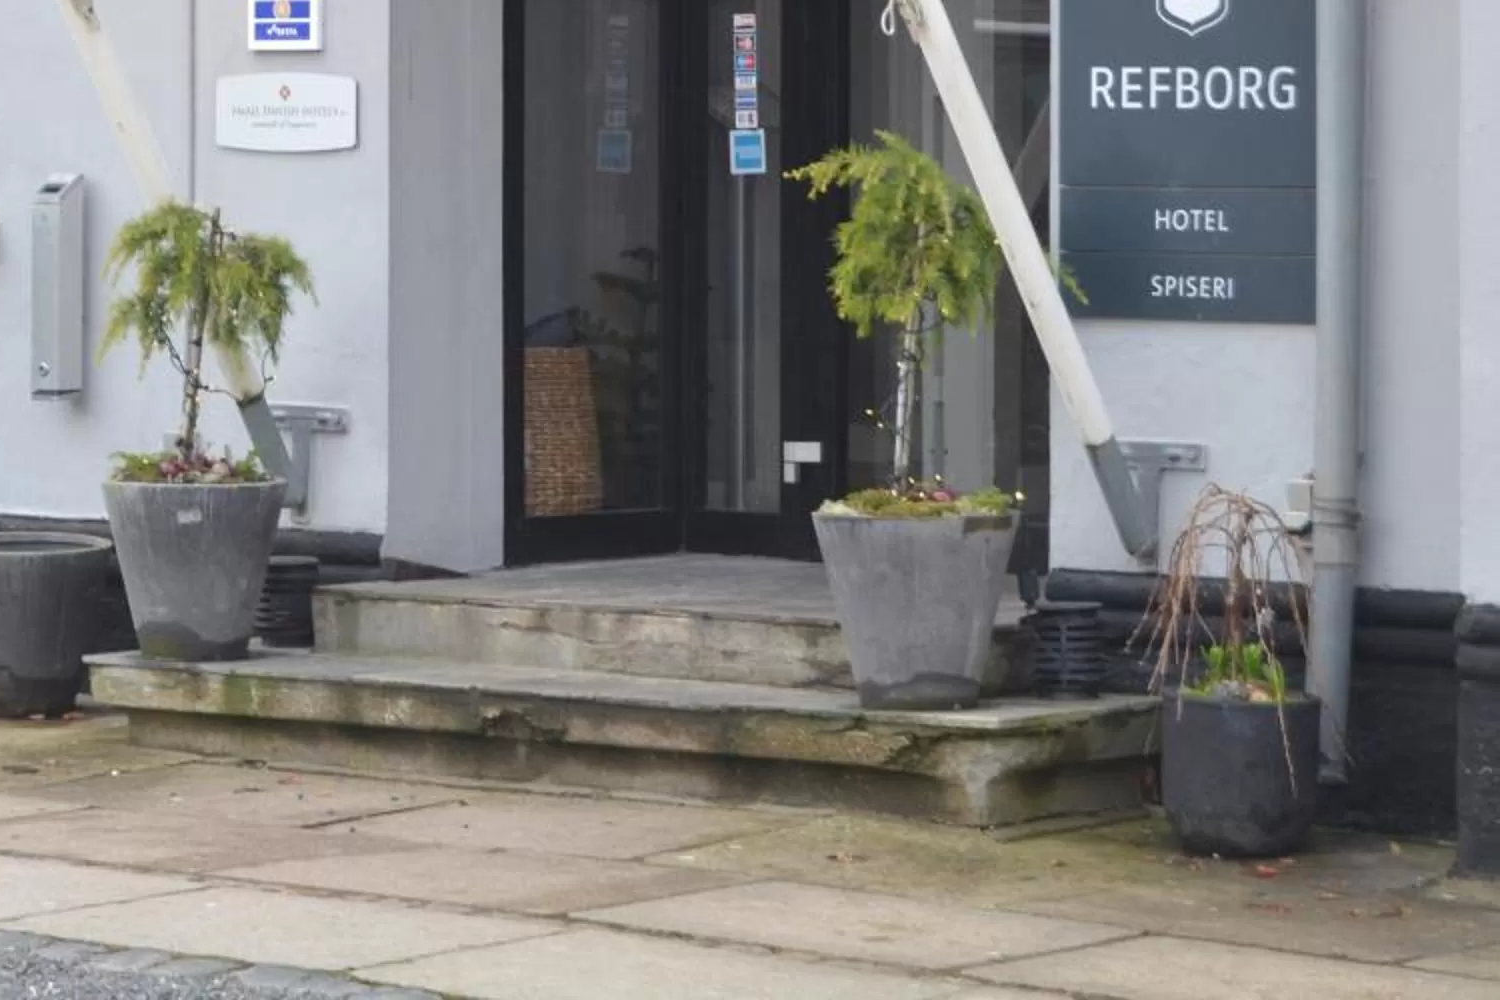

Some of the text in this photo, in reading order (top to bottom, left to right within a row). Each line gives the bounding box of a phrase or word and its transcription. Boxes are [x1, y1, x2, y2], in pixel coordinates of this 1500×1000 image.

[1089, 65, 1297, 110] REFBORG
[1154, 208, 1230, 233] HOTEL
[1150, 275, 1234, 299] SPISERI
